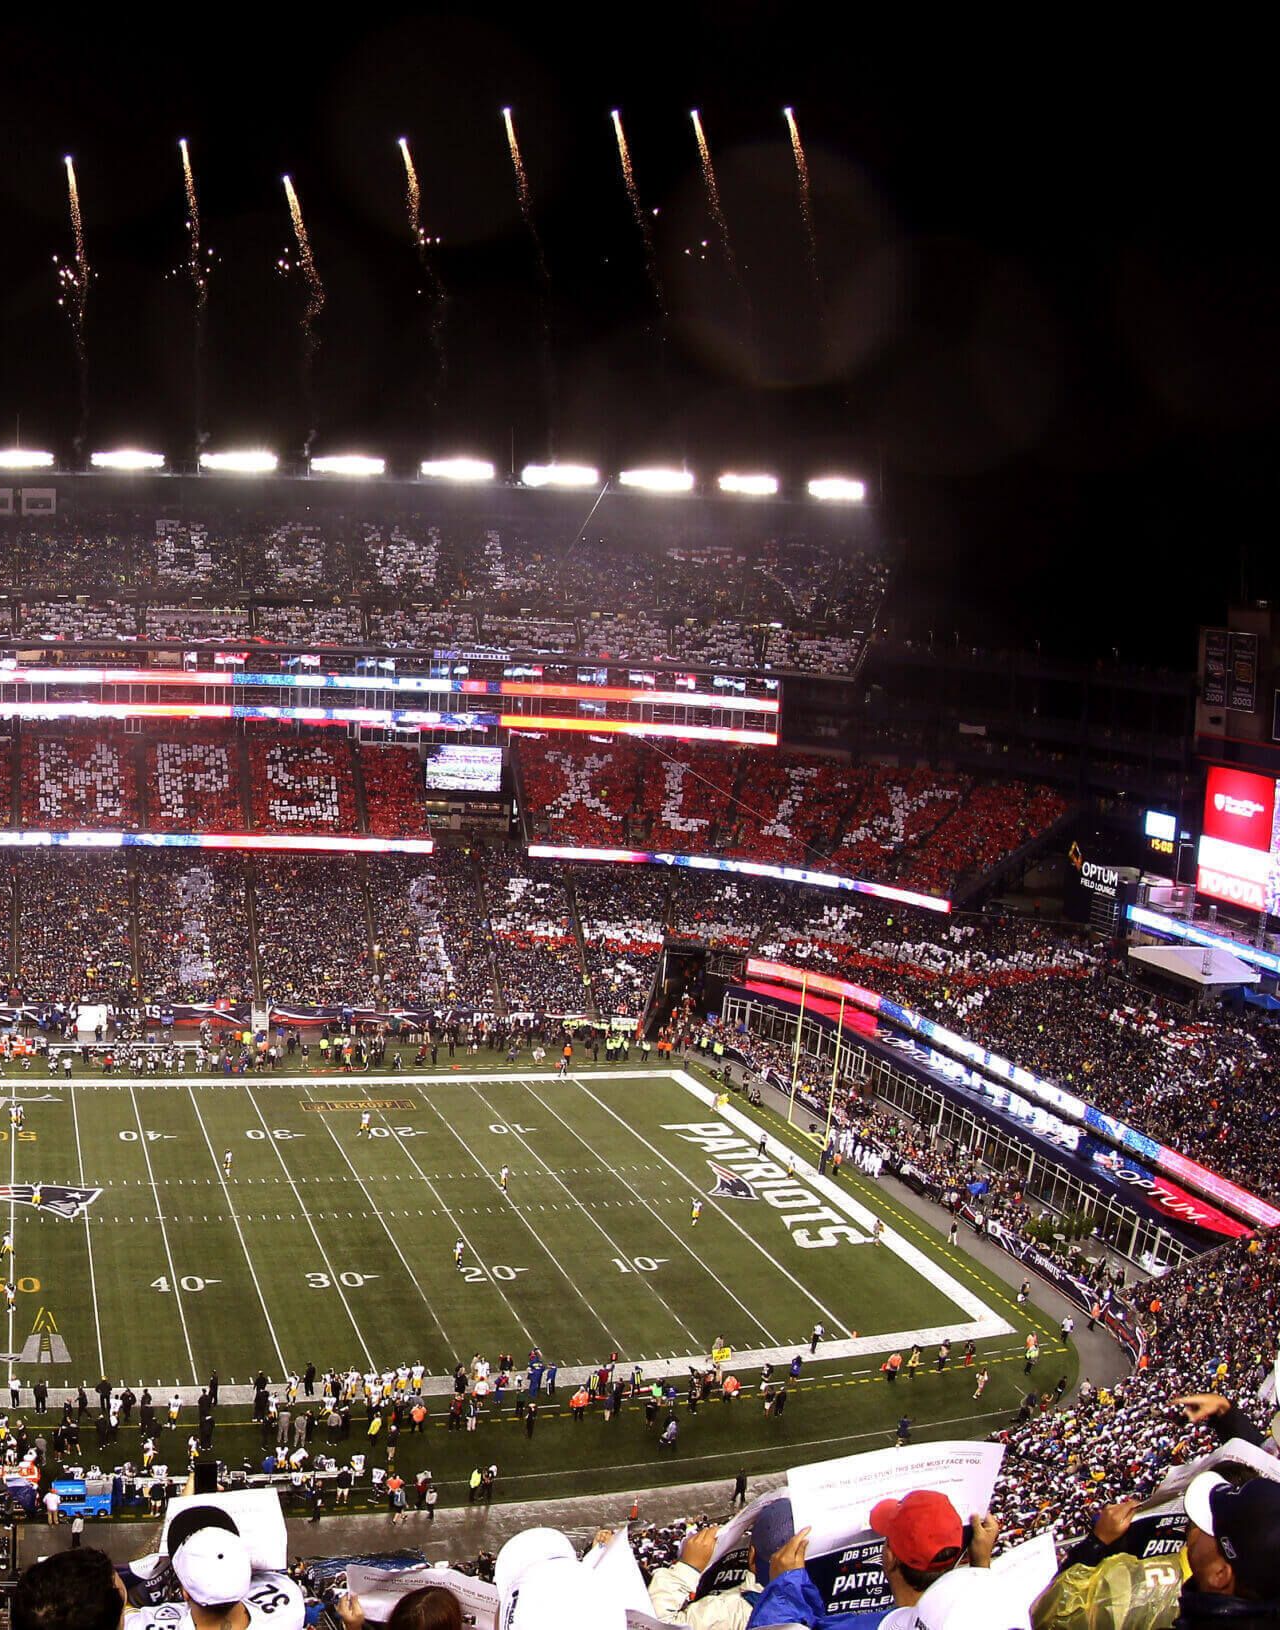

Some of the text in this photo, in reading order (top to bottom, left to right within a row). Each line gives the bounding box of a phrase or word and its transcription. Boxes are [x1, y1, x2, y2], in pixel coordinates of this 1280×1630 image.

[1082, 861, 1118, 887] OPTUM
[1080, 877, 1117, 897] FIELD LOUNGE
[1200, 867, 1264, 906] TOYOTA
[334, 1100, 394, 1109] KICKOFF
[660, 1122, 873, 1250] PATRIOTS
[1115, 1169, 1208, 1222] OPTUM
[460, 1265, 518, 1282] 20
[611, 1256, 659, 1273] 10
[1034, 1253, 1061, 1281] PATRIOTS
[150, 1274, 206, 1293] 40
[305, 1272, 366, 1288] 30
[839, 1549, 859, 1564] JOB
[831, 1570, 889, 1596] PATRI
[865, 1586, 883, 1595] VS
[249, 1583, 291, 1614] 32
